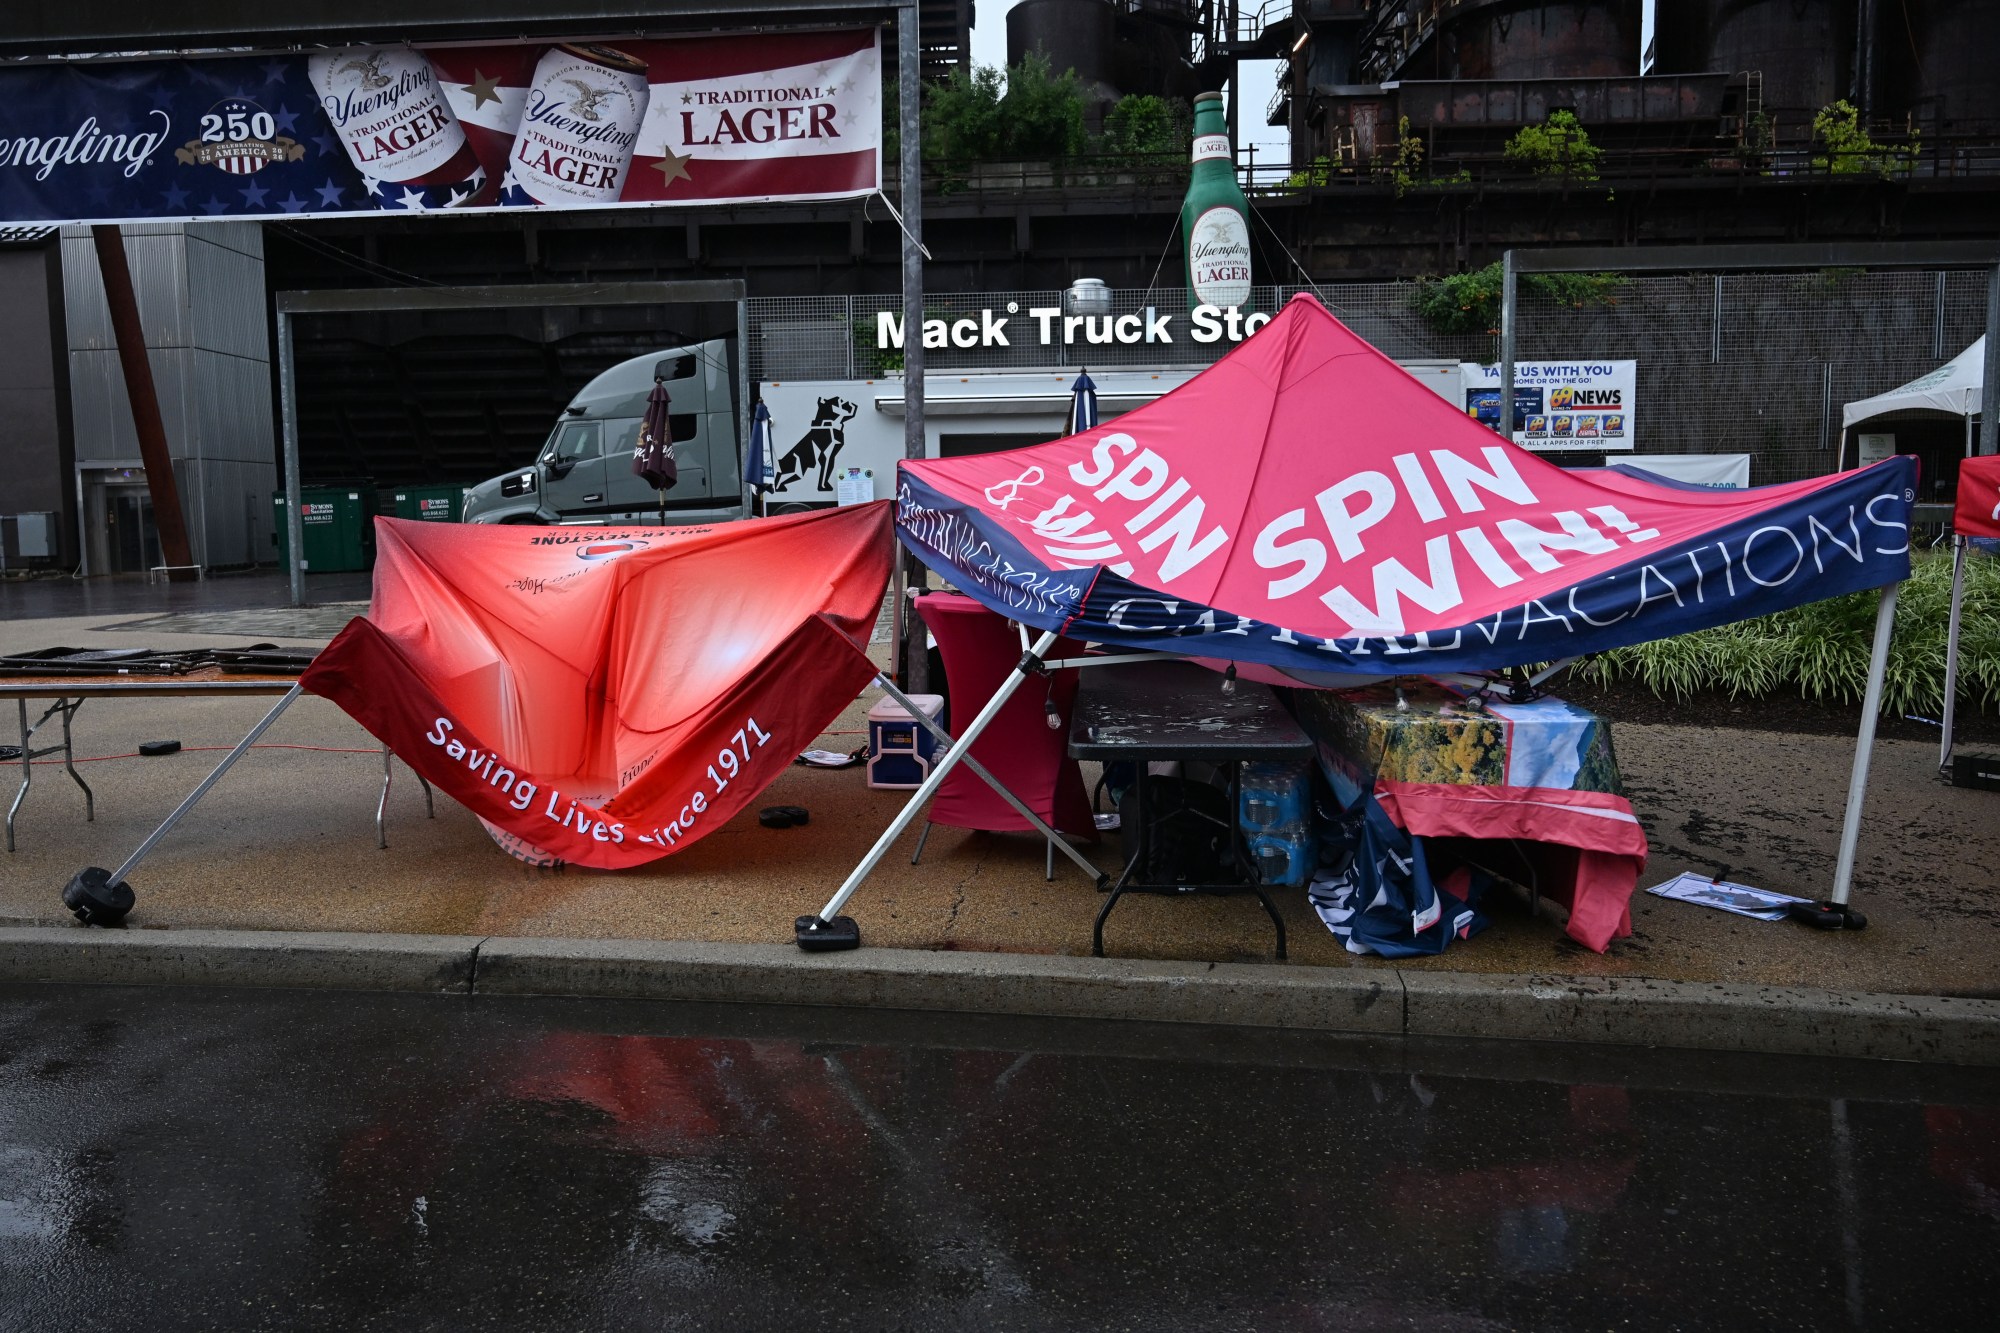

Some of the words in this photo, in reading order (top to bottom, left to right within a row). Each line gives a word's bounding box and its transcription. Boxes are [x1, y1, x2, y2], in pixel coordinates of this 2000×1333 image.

[585, 66, 618, 80] OLDEST
[325, 65, 430, 127] Yuengling
[695, 87, 824, 105] TRADITIONAL
[201, 112, 275, 142] 250
[352, 104, 450, 162] LAGER
[353, 97, 432, 138] TRADITIONAL
[525, 89, 641, 152] Yuengling
[680, 103, 841, 146] LAGER
[215, 148, 267, 158] AMERICA
[518, 138, 618, 190] LAGER
[534, 130, 615, 164] TRADITIONAL
[1199, 144, 1228, 154] LAGER
[1191, 240, 1249, 263] Yuengling
[1202, 260, 1244, 268] TRADITIONAL
[1197, 267, 1249, 284] LAGER
[1029, 306, 1173, 345] Truck
[1190, 304, 1279, 343] Sto
[1482, 367, 1517, 377] TA
[1521, 367, 1538, 377] US
[1543, 366, 1580, 376] WITH
[1583, 366, 1613, 375] YOU
[1550, 386, 1573, 407] 69
[1573, 389, 1621, 404] NEWS
[1067, 432, 1230, 584] SPIN
[1252, 446, 1540, 600] SPIN
[1318, 504, 1661, 636] WIN!
[426, 717, 539, 810] Saving
[545, 790, 625, 844] Lives
[706, 716, 774, 794] 1971
